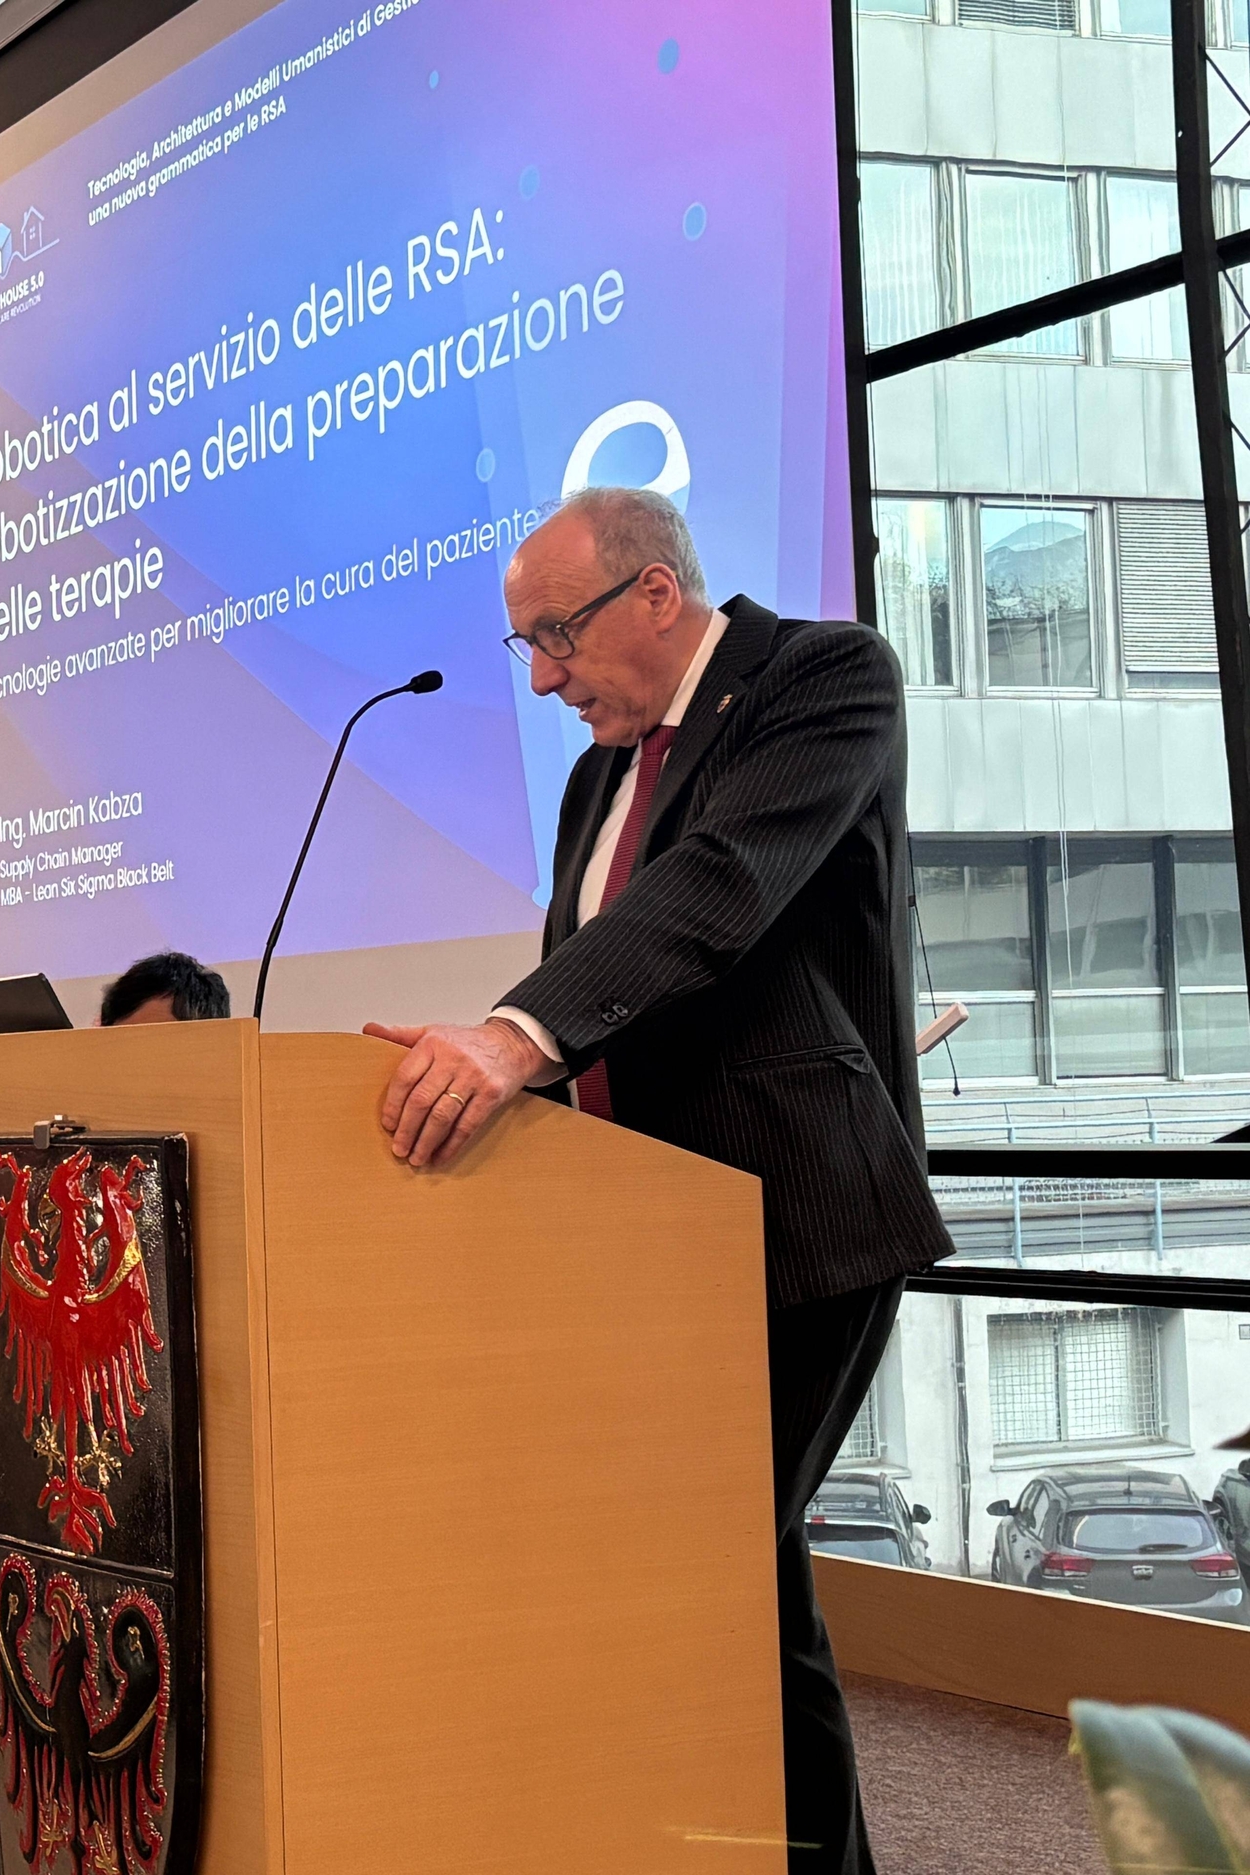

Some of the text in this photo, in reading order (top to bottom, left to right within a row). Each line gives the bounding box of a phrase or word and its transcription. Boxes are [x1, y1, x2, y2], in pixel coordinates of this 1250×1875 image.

[88, 151, 150, 199] Tecnologia,
[152, 106, 222, 161] Architettura
[224, 100, 232, 117] e
[234, 65, 280, 111] Modelli
[283, 19, 354, 82] Umanistici
[357, 9, 371, 37] di
[88, 95, 287, 226] una nuova grammatica per le RSA
[0, 279, 29, 310] HOUSE
[30, 270, 45, 292] 5.0
[108, 368, 138, 432] al
[148, 311, 281, 416] servizio
[292, 259, 393, 350] delle
[407, 207, 504, 300] RSA:
[202, 400, 294, 480] della
[306, 268, 625, 462] preparazione
[49, 538, 164, 620] terapie
[64, 631, 146, 678] avanzate
[150, 620, 182, 663] per
[187, 595, 290, 643] migliorare
[295, 575, 315, 608] la
[321, 560, 374, 599] cura
[381, 537, 418, 582] del
[426, 508, 539, 581] paziente
[0, 840, 124, 883] Supply Chain Manager
[29, 799, 85, 837] Marcin
[89, 790, 143, 825] Kabza
[0, 888, 23, 907] MBA
[33, 880, 59, 902] Lean
[61, 876, 76, 897] Six
[78, 873, 115, 900] Sigma
[117, 864, 149, 889] Black
[151, 859, 175, 882] Belt
